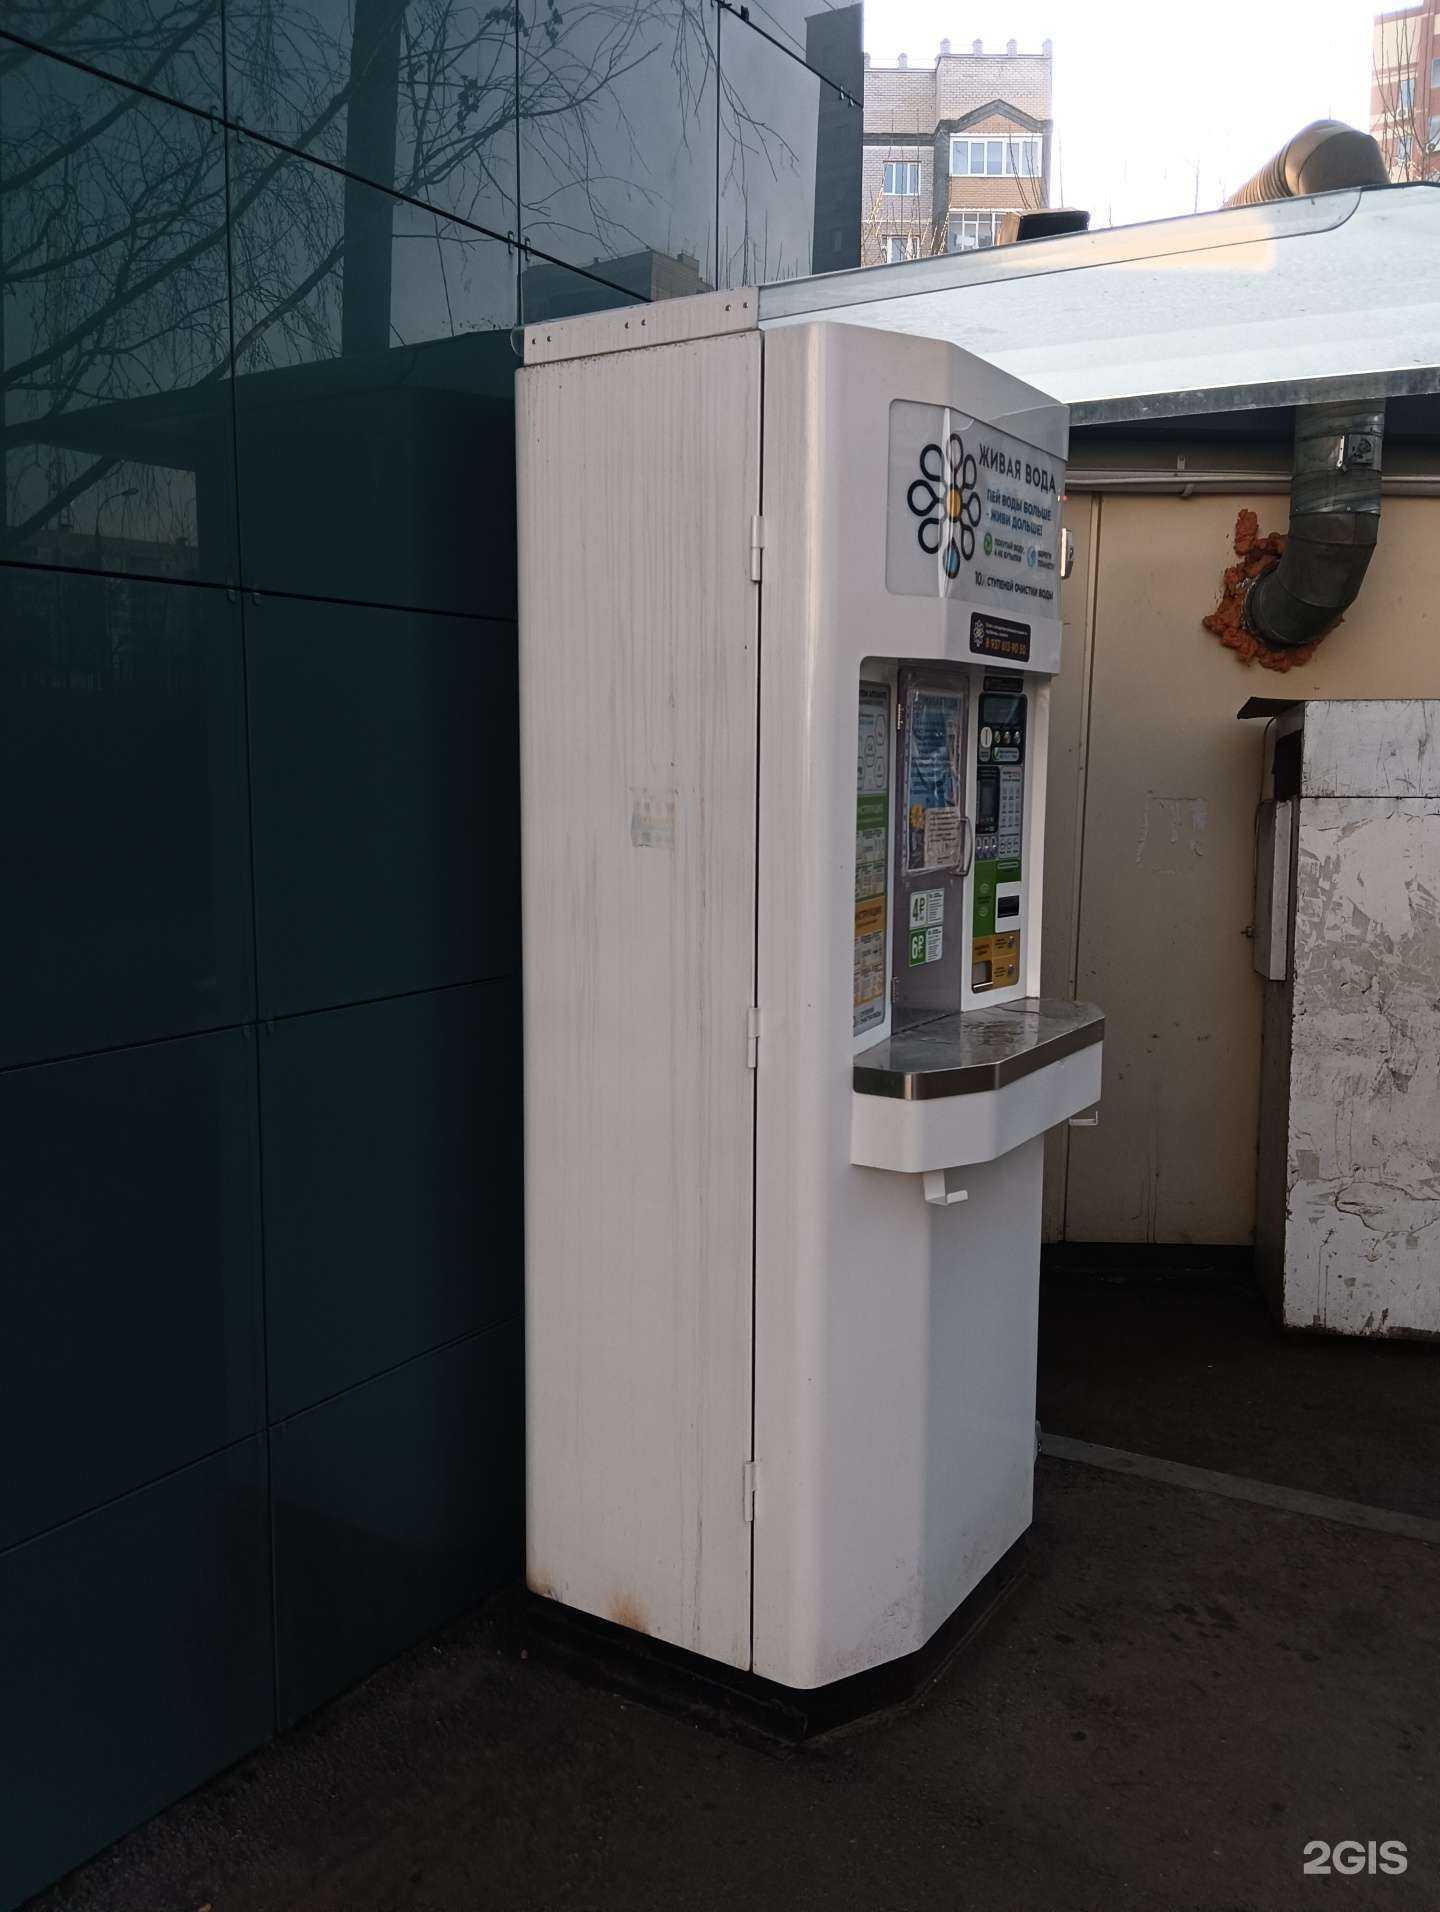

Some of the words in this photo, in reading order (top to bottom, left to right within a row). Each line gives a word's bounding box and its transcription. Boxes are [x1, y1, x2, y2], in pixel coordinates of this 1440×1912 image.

[979, 444, 1021, 480] ЖИВАЯ
[1025, 463, 1056, 494] ВОДА
[986, 488, 1001, 503] ПЕЙ
[1002, 494, 1022, 512] ВОДЫ
[1023, 502, 1051, 521] БОЛЬШЕ
[987, 576, 1014, 593] СТУПЕНЕЙ
[1038, 588, 1054, 600] ВОДЫ
